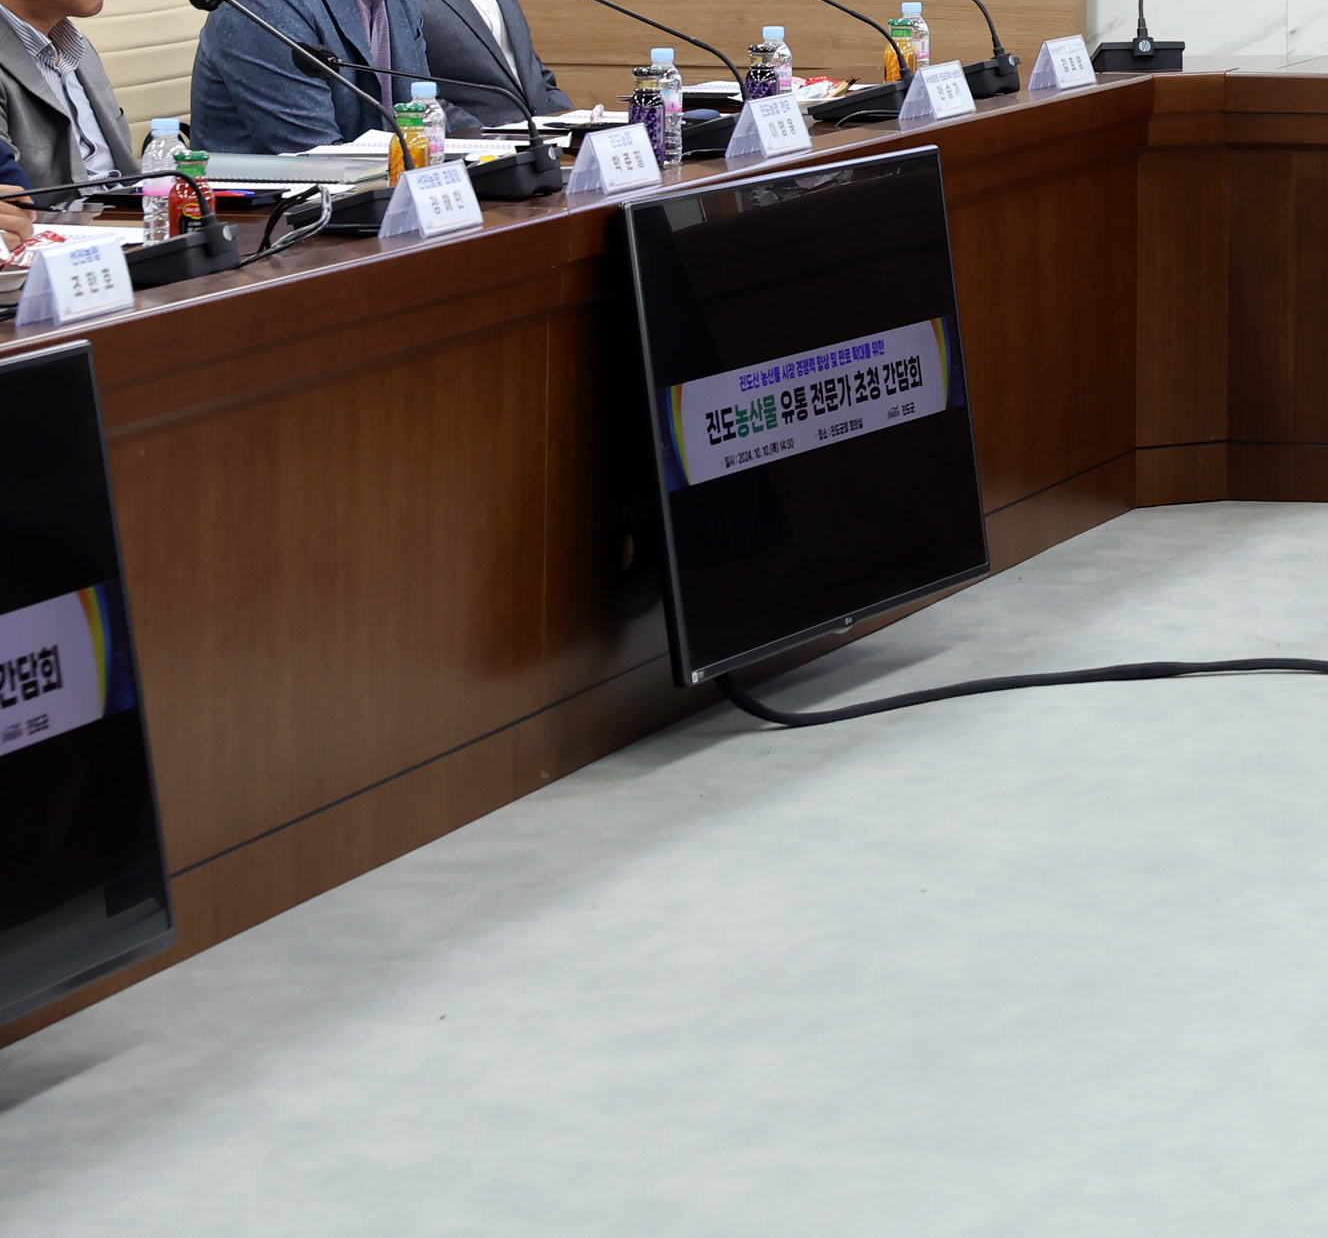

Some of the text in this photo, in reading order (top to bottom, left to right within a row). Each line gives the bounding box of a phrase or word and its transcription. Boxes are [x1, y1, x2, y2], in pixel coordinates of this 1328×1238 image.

[706, 355, 923, 445] 진도농산물 유통 전문가 초청 간담회
